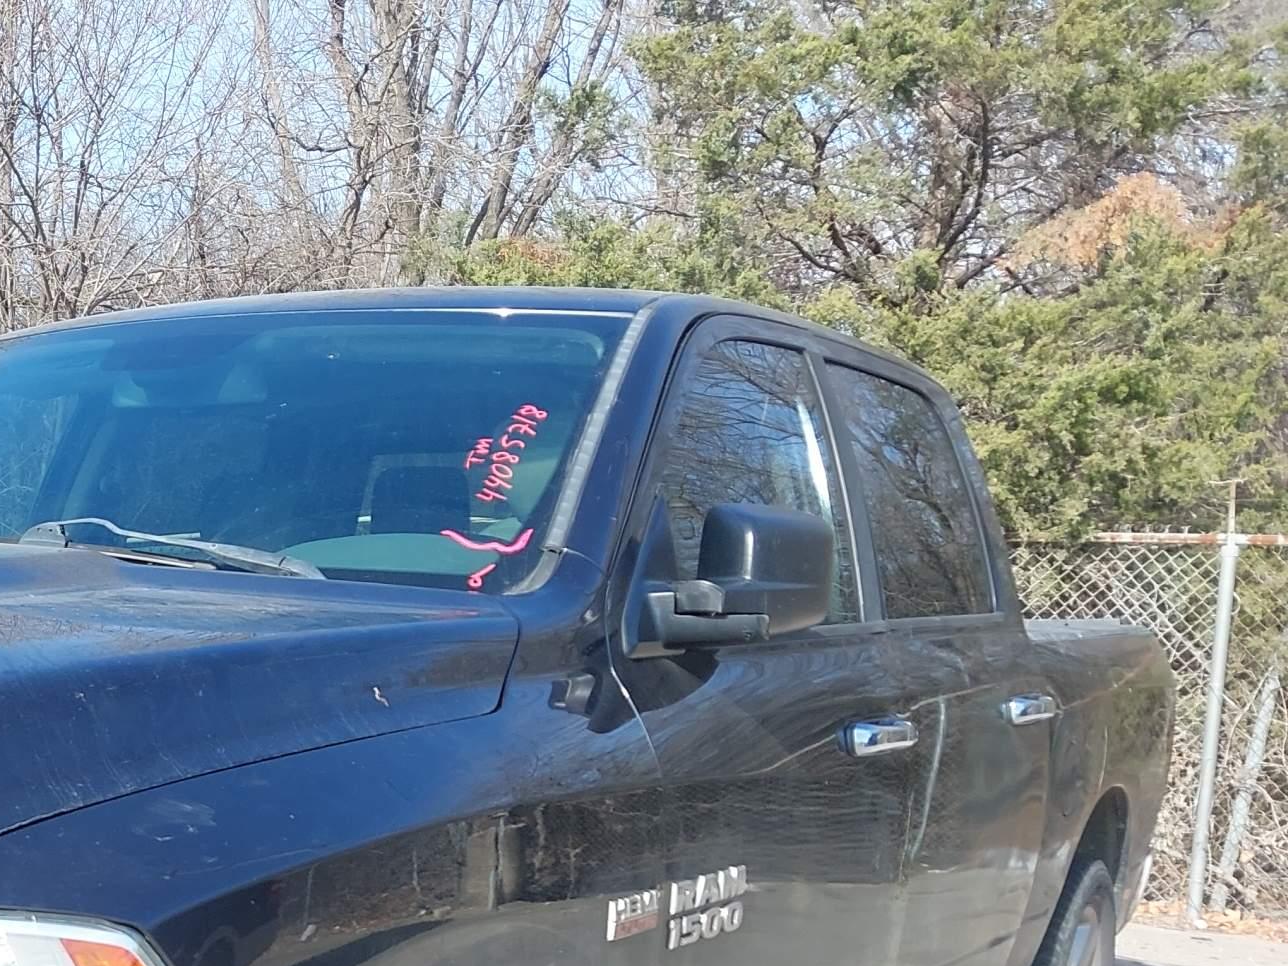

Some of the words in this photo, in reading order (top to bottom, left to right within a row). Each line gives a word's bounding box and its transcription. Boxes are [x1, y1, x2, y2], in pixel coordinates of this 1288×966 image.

[475, 402, 549, 502] 44085718
[669, 864, 747, 917] RAM
[667, 900, 744, 950] 1500
